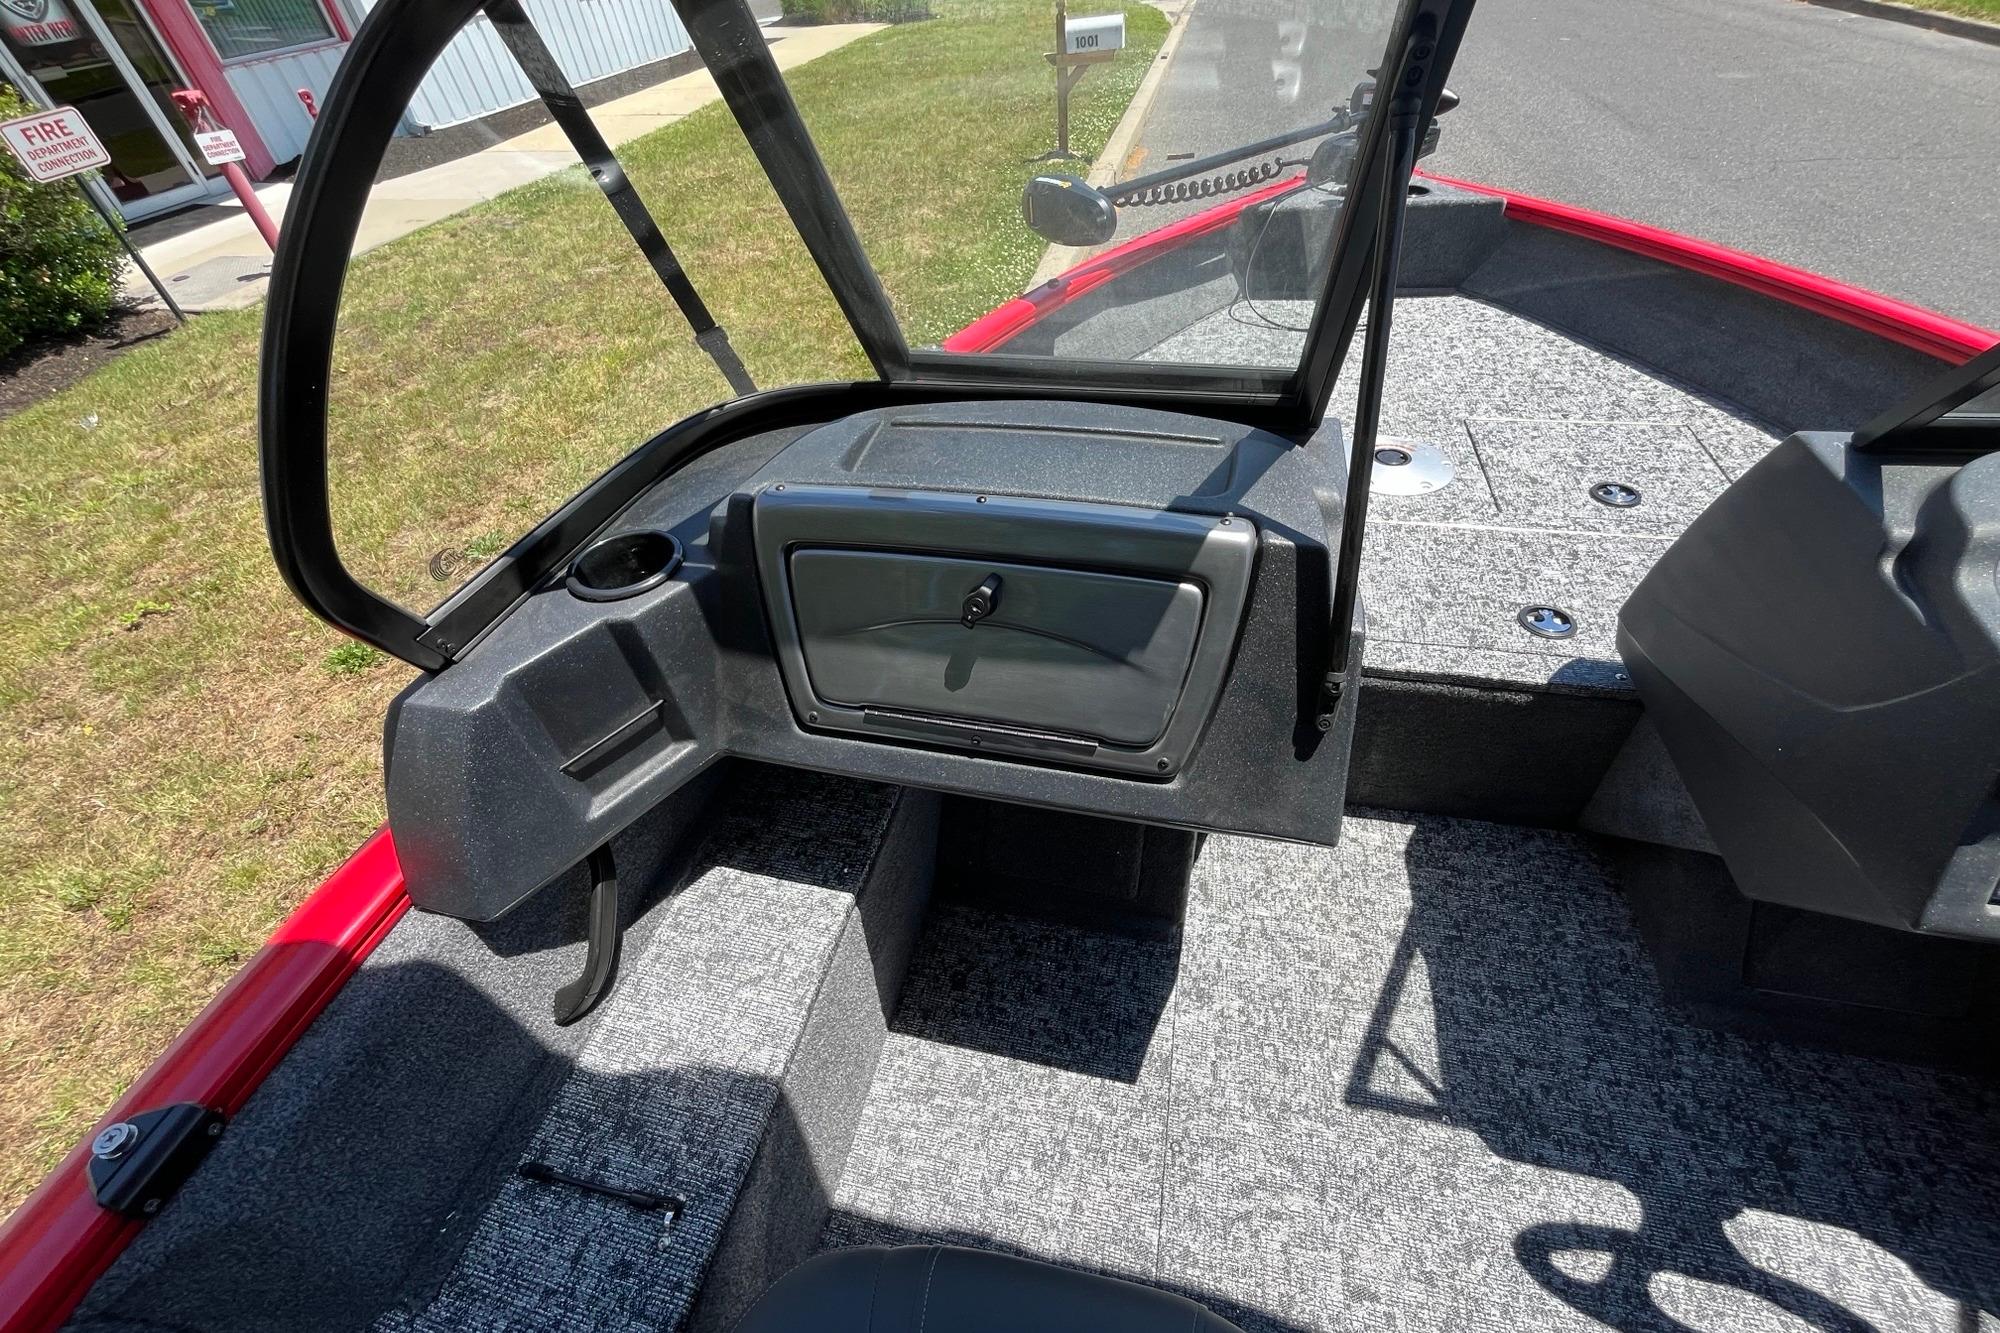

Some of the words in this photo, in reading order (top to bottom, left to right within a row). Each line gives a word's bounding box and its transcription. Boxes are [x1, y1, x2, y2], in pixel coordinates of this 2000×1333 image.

[1075, 34, 1099, 49] 1001
[20, 118, 74, 146] FIRE
[26, 136, 90, 161] DEPARTMENT
[202, 140, 237, 151] DEPARTMENT
[37, 148, 98, 173] CONNECTION
